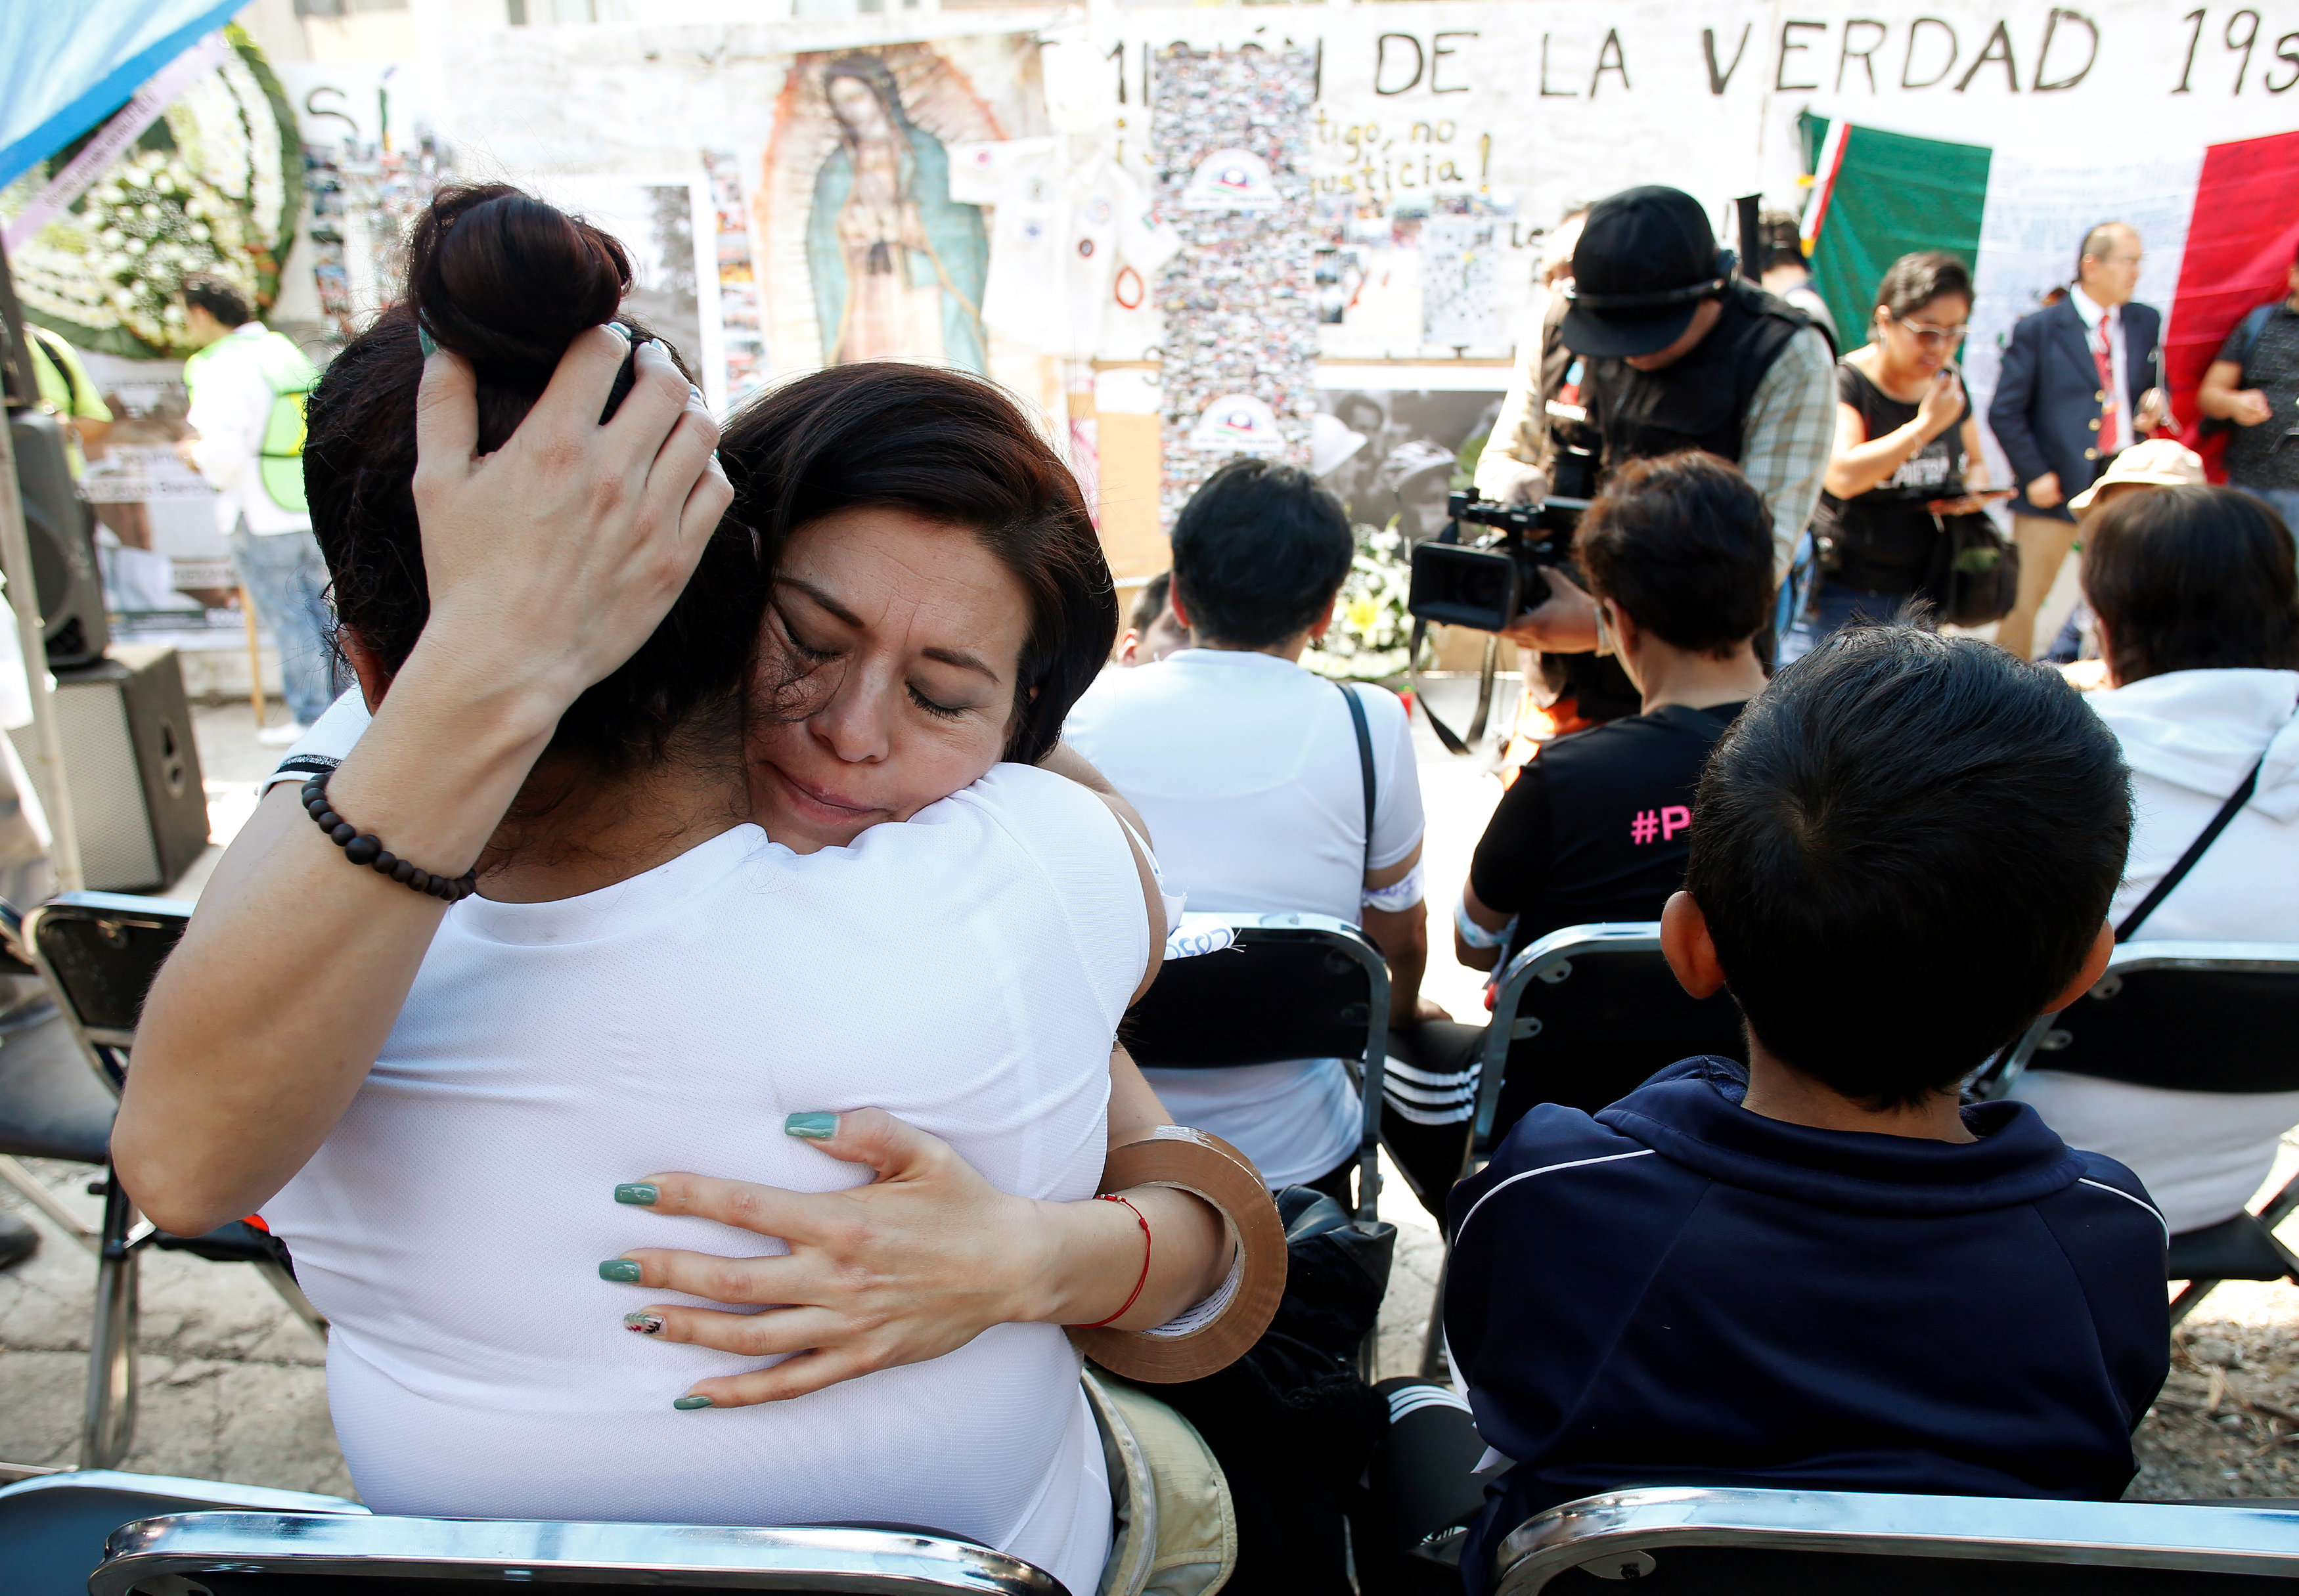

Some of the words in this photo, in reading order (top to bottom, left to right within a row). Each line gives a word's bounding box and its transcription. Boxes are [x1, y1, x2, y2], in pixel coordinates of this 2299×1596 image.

[1376, 32, 1480, 96] DE
[1541, 28, 1630, 97] LA
[1704, 7, 2100, 96] VERDAD
[1412, 120, 1456, 143] no
[1630, 805, 1691, 845] #P
